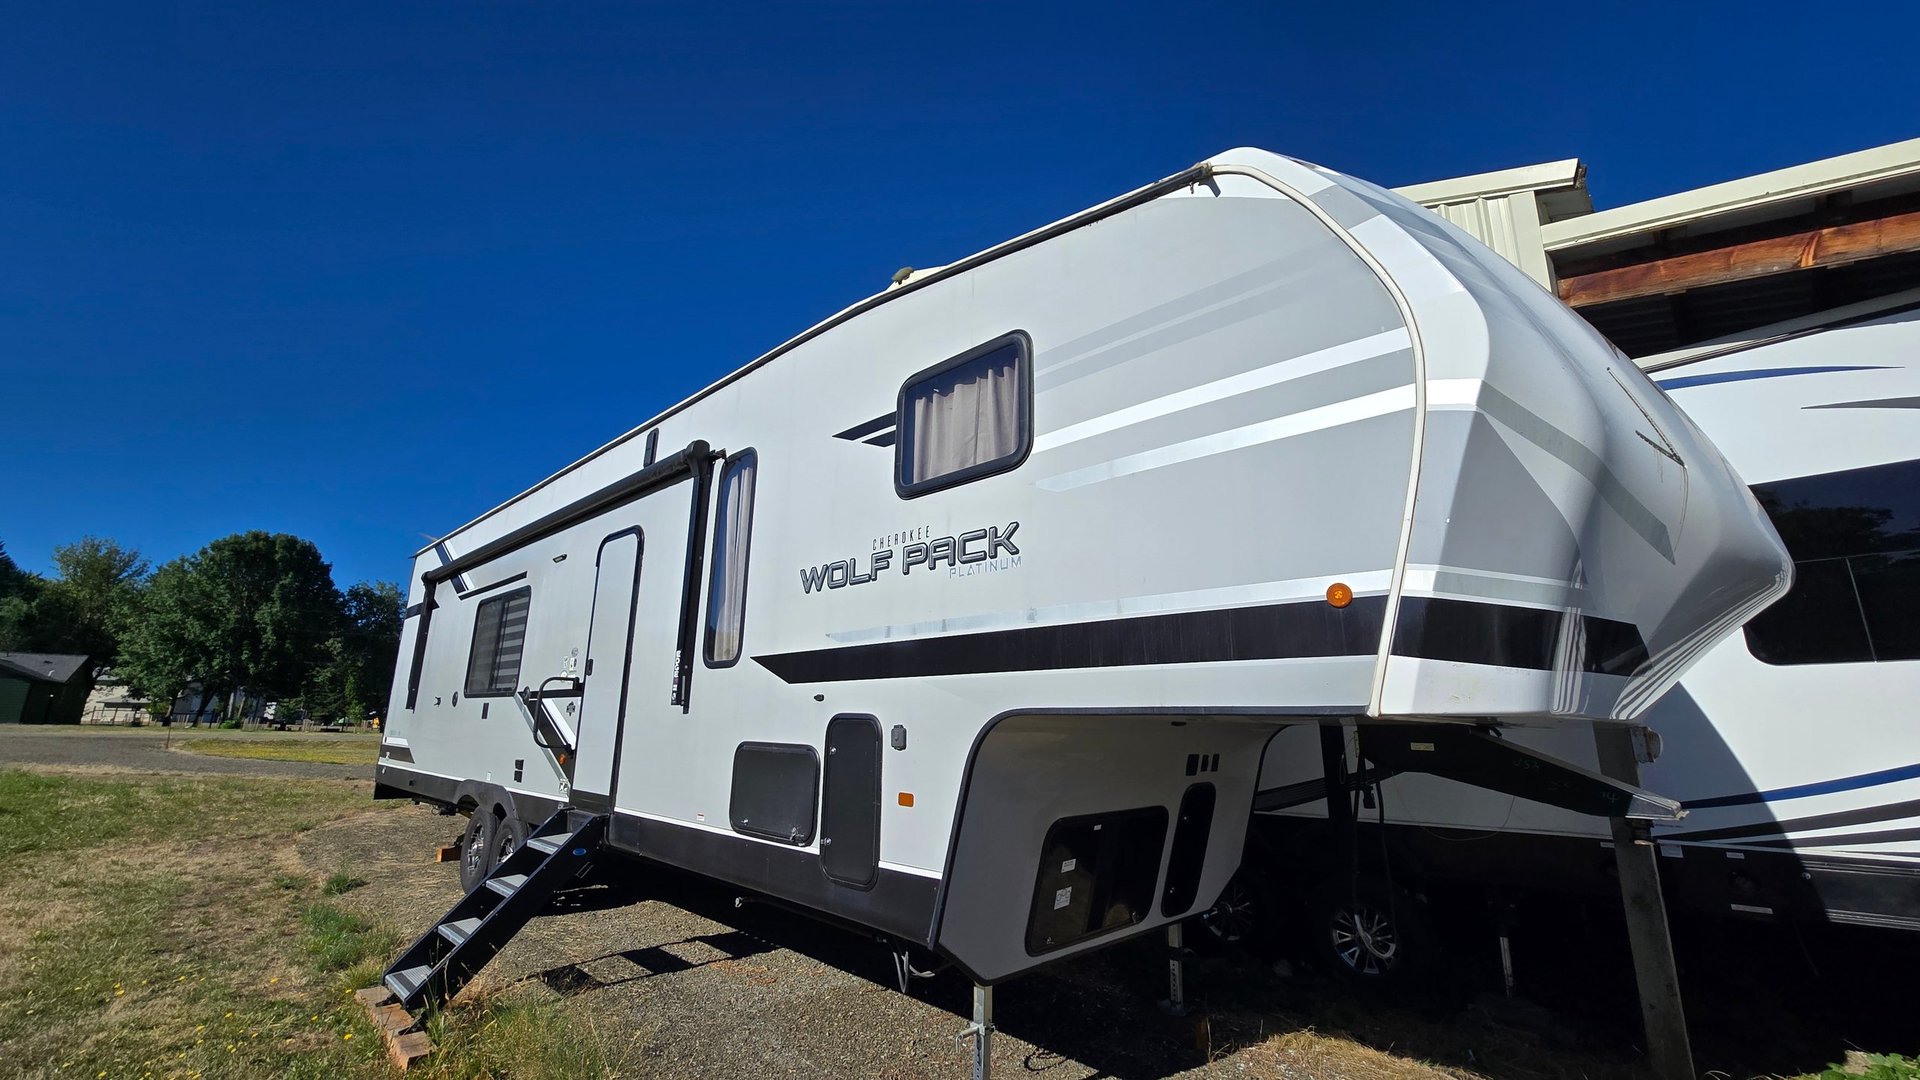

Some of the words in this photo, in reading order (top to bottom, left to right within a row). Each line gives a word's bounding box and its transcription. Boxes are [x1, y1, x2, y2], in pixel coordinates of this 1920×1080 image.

[872, 525, 930, 550] CHEROKEE
[800, 550, 893, 594] WOLF
[902, 521, 1020, 575] PACK
[949, 556, 1021, 579] PLATINUM
